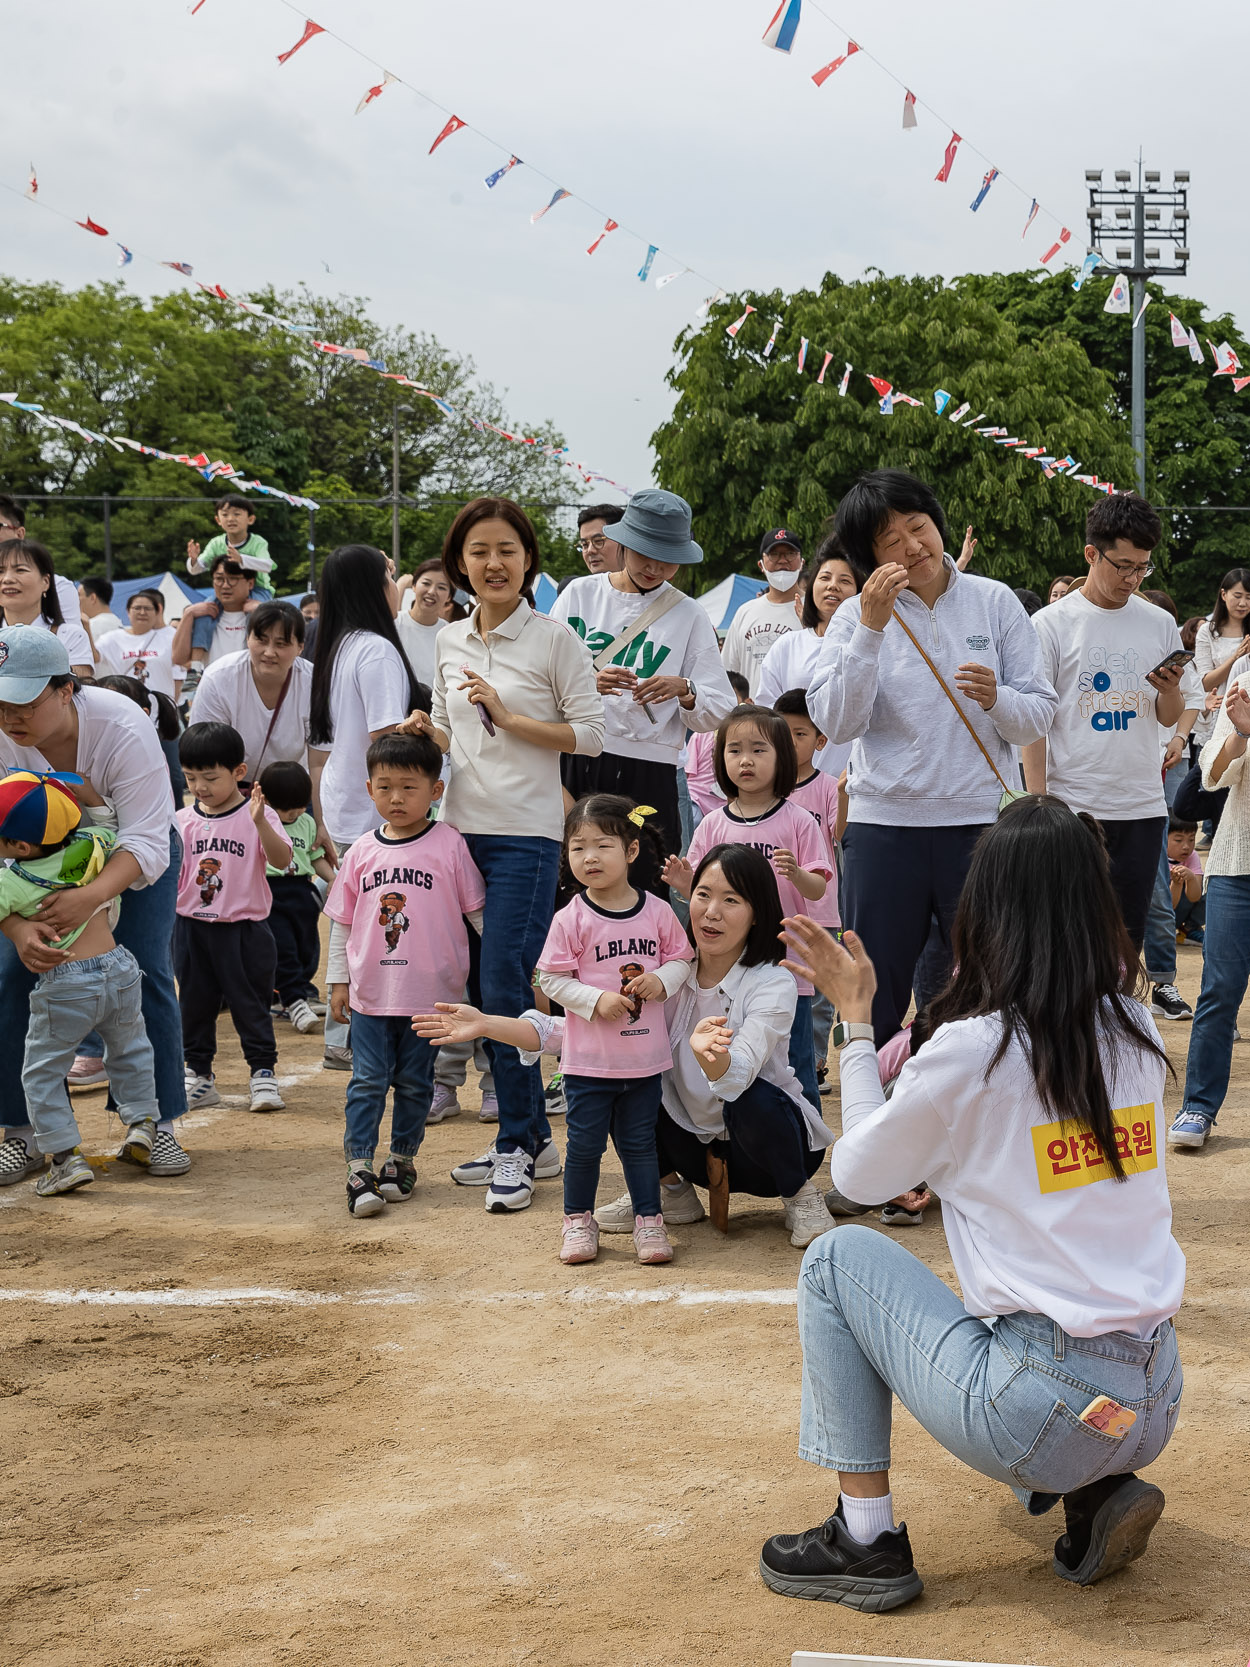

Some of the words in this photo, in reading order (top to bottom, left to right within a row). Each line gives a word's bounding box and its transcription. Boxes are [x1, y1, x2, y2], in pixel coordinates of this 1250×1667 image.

[745, 623, 771, 640] WILD
[1088, 647, 1139, 673] get
[1078, 671, 1152, 693] some
[1078, 691, 1151, 718] fresh
[1091, 711, 1137, 731] air
[190, 837, 245, 858] .BLANCS
[362, 867, 434, 894] L.BLANCS
[595, 938, 657, 962] L.BLANC
[1047, 1120, 1153, 1175] 안전요원
